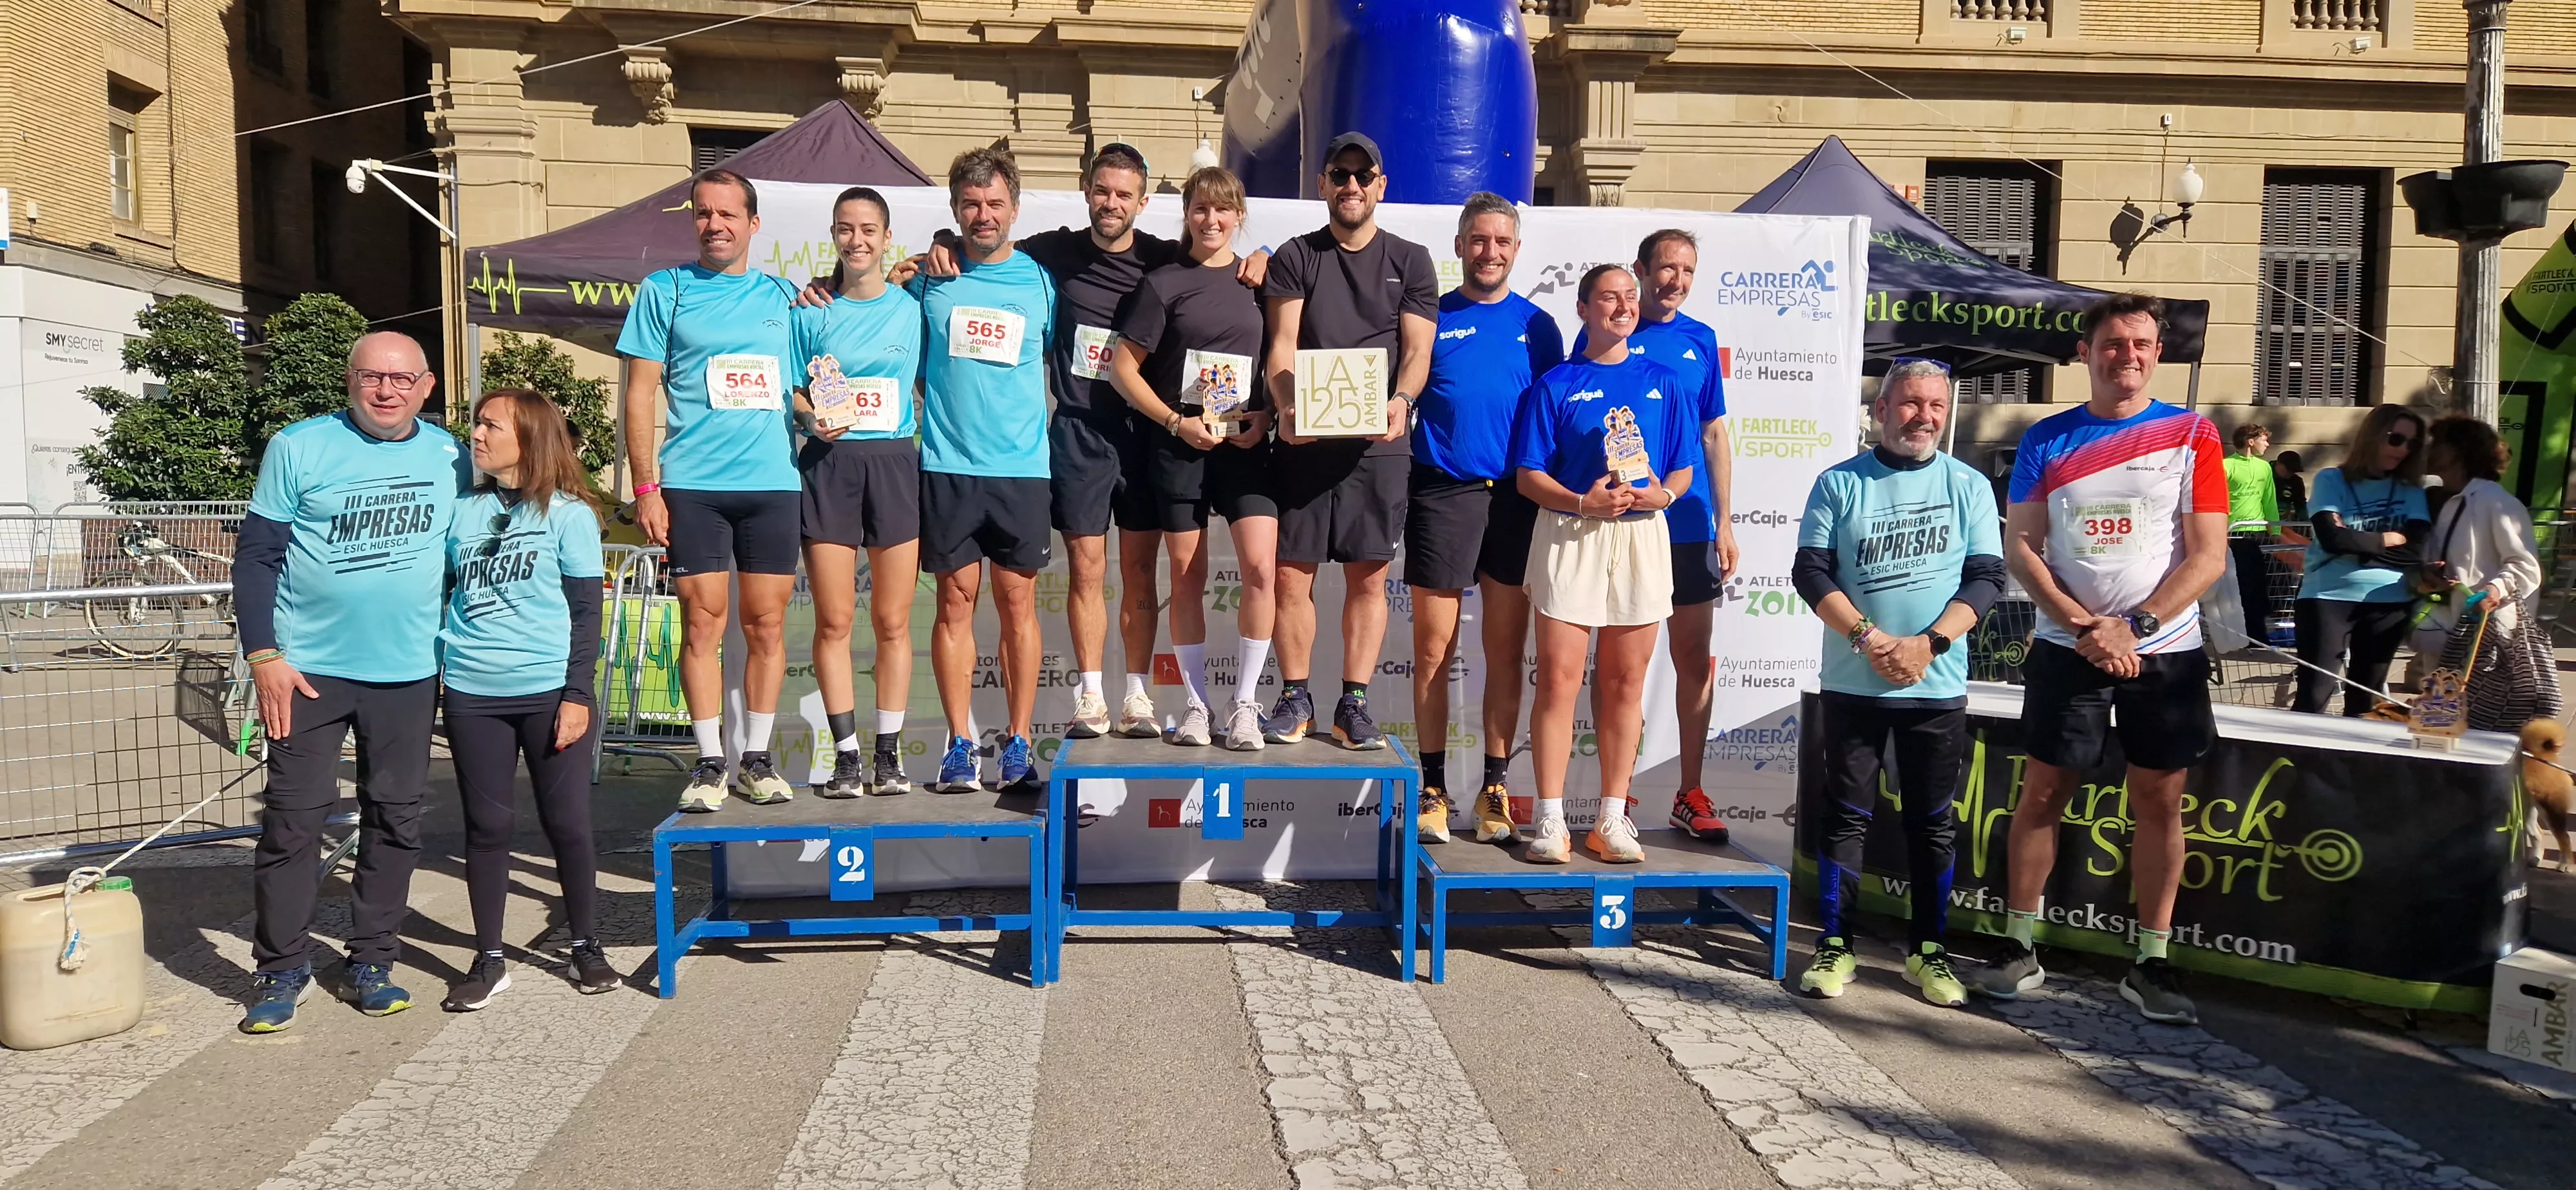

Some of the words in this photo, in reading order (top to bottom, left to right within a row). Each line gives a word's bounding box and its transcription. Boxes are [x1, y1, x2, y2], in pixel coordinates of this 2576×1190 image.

[1721, 272, 1818, 289] CARRERA
[1718, 289, 1821, 307] EMPRESAS
[1801, 310, 1810, 319] By
[1865, 291, 2085, 336] tlecksport.co
[966, 320, 1006, 339] 565
[46, 332, 66, 347] SMY
[68, 335, 104, 352] secret
[969, 338, 1001, 348] JORGE
[969, 345, 982, 354] 8K
[1087, 345, 1113, 363] 50
[1735, 347, 1837, 365] Ayuntamiento
[725, 373, 767, 388] 564
[1089, 370, 1101, 379] 8K
[1311, 355, 1358, 402] LA
[1734, 366, 1752, 380] de
[1758, 366, 1814, 382] Huesca
[822, 388, 851, 407] EMPRESAS
[850, 392, 882, 408] 63
[1211, 399, 1240, 413] EMPRESAS
[1363, 368, 1377, 428] AMBAR
[1301, 386, 1361, 429] 125
[828, 417, 835, 429] 2
[1214, 426, 1219, 436] 1
[1741, 417, 1817, 435] FARTLECK
[1615, 441, 1643, 459] EMPRESAS
[1745, 442, 1817, 458] SPORT
[1620, 470, 1627, 482] 3
[345, 495, 362, 510] III
[365, 491, 416, 507] CARRERA
[327, 503, 435, 545] EMPRESAS
[1730, 510, 1787, 529] erCaja
[1871, 521, 1886, 534] III
[1888, 515, 1932, 533] CARRERA
[2084, 517, 2132, 536] 398
[344, 542, 366, 554] ESIC
[370, 537, 409, 551] HUESCA
[1855, 524, 1951, 568] EMPRESAS
[2090, 546, 2106, 554] 8K
[2094, 537, 2123, 545] JOSE
[459, 546, 473, 562] III
[458, 550, 539, 594] MPRESAS
[1870, 564, 1890, 576] ESIC
[1893, 558, 1927, 572] HUESCA
[1749, 576, 1795, 587] ATLET
[478, 585, 509, 600] HUESCA
[1719, 656, 1817, 673] Ayuntamiento
[972, 669, 1081, 688] CAERO
[1215, 672, 1274, 685] Huca
[1718, 674, 1736, 688] de
[1741, 674, 1795, 688] Huesca
[1186, 798, 1294, 815] Aymiento
[1213, 782, 1231, 817] 1
[1184, 815, 1203, 829] de
[837, 846, 865, 883] 2
[2087, 816, 2284, 904] Sort
[1600, 895, 1626, 929] 3
[2541, 980, 2570, 1067] AMBAR
